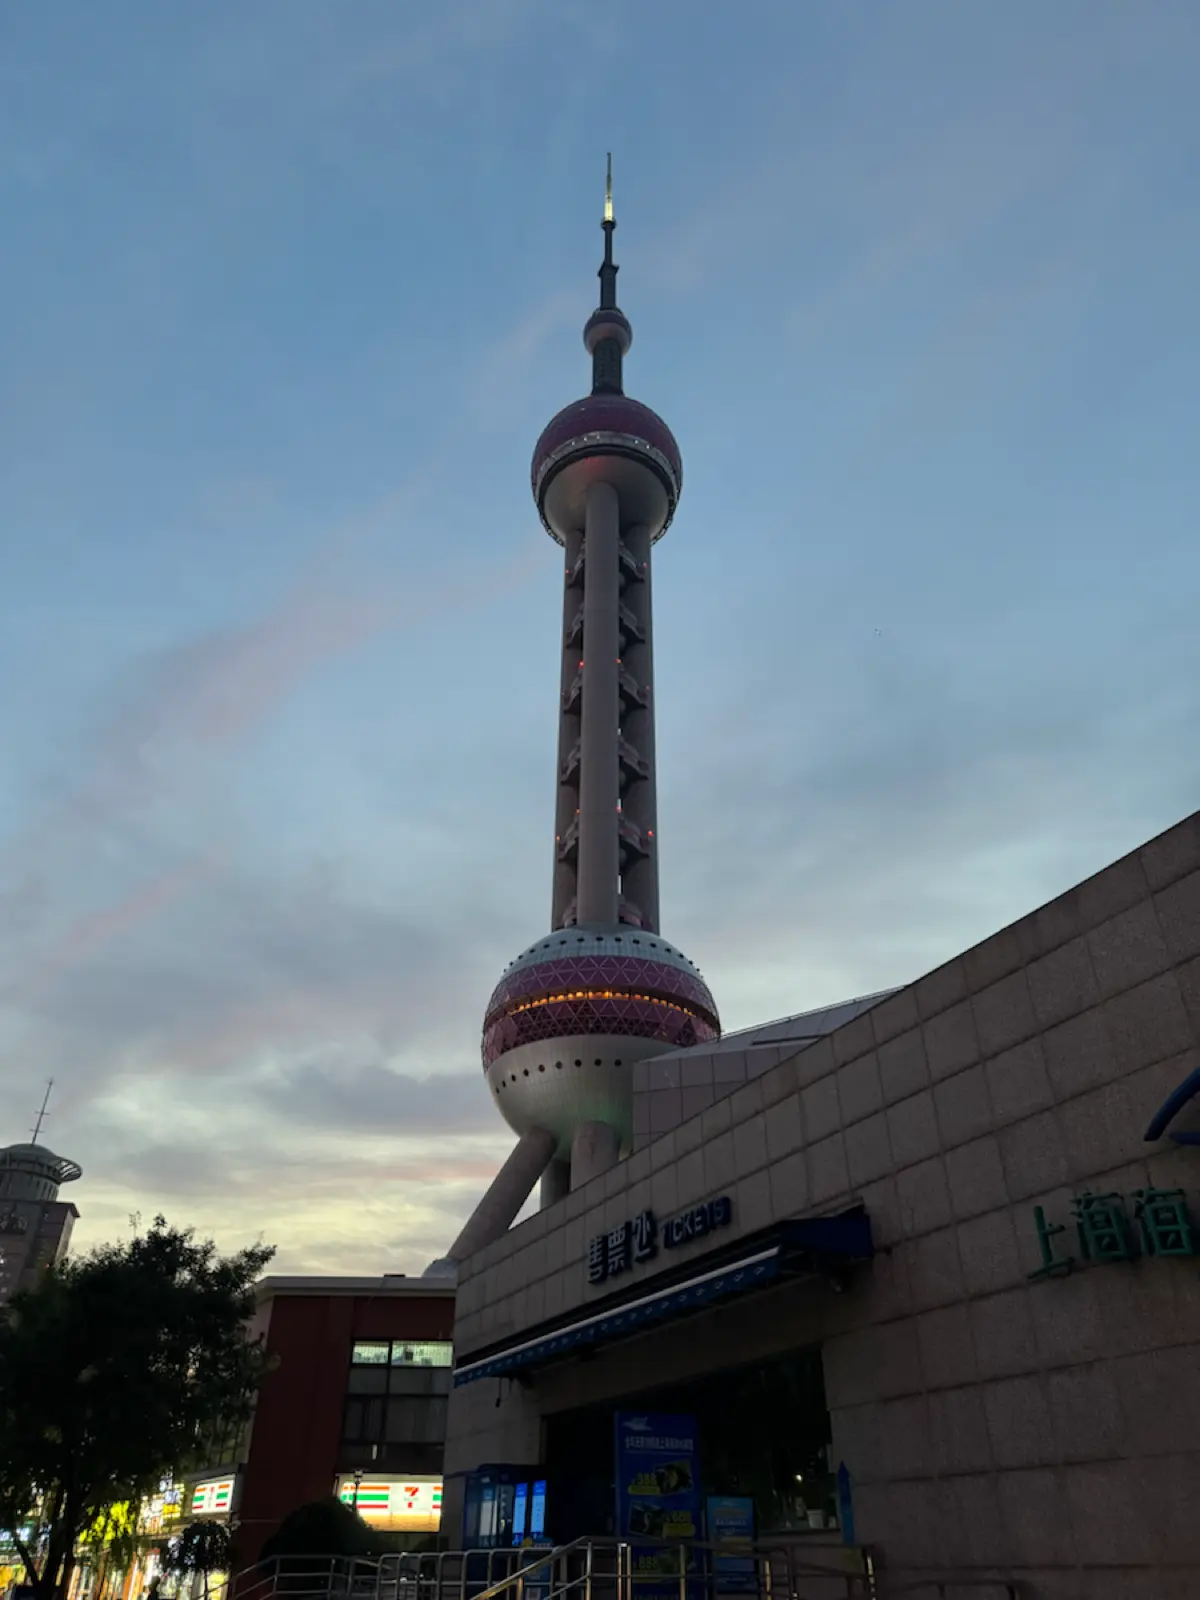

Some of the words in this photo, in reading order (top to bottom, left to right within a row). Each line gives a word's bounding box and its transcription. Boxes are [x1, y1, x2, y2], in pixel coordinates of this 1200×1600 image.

[588, 1210, 657, 1283] 售票处
[660, 1196, 731, 1249] TICKETS
